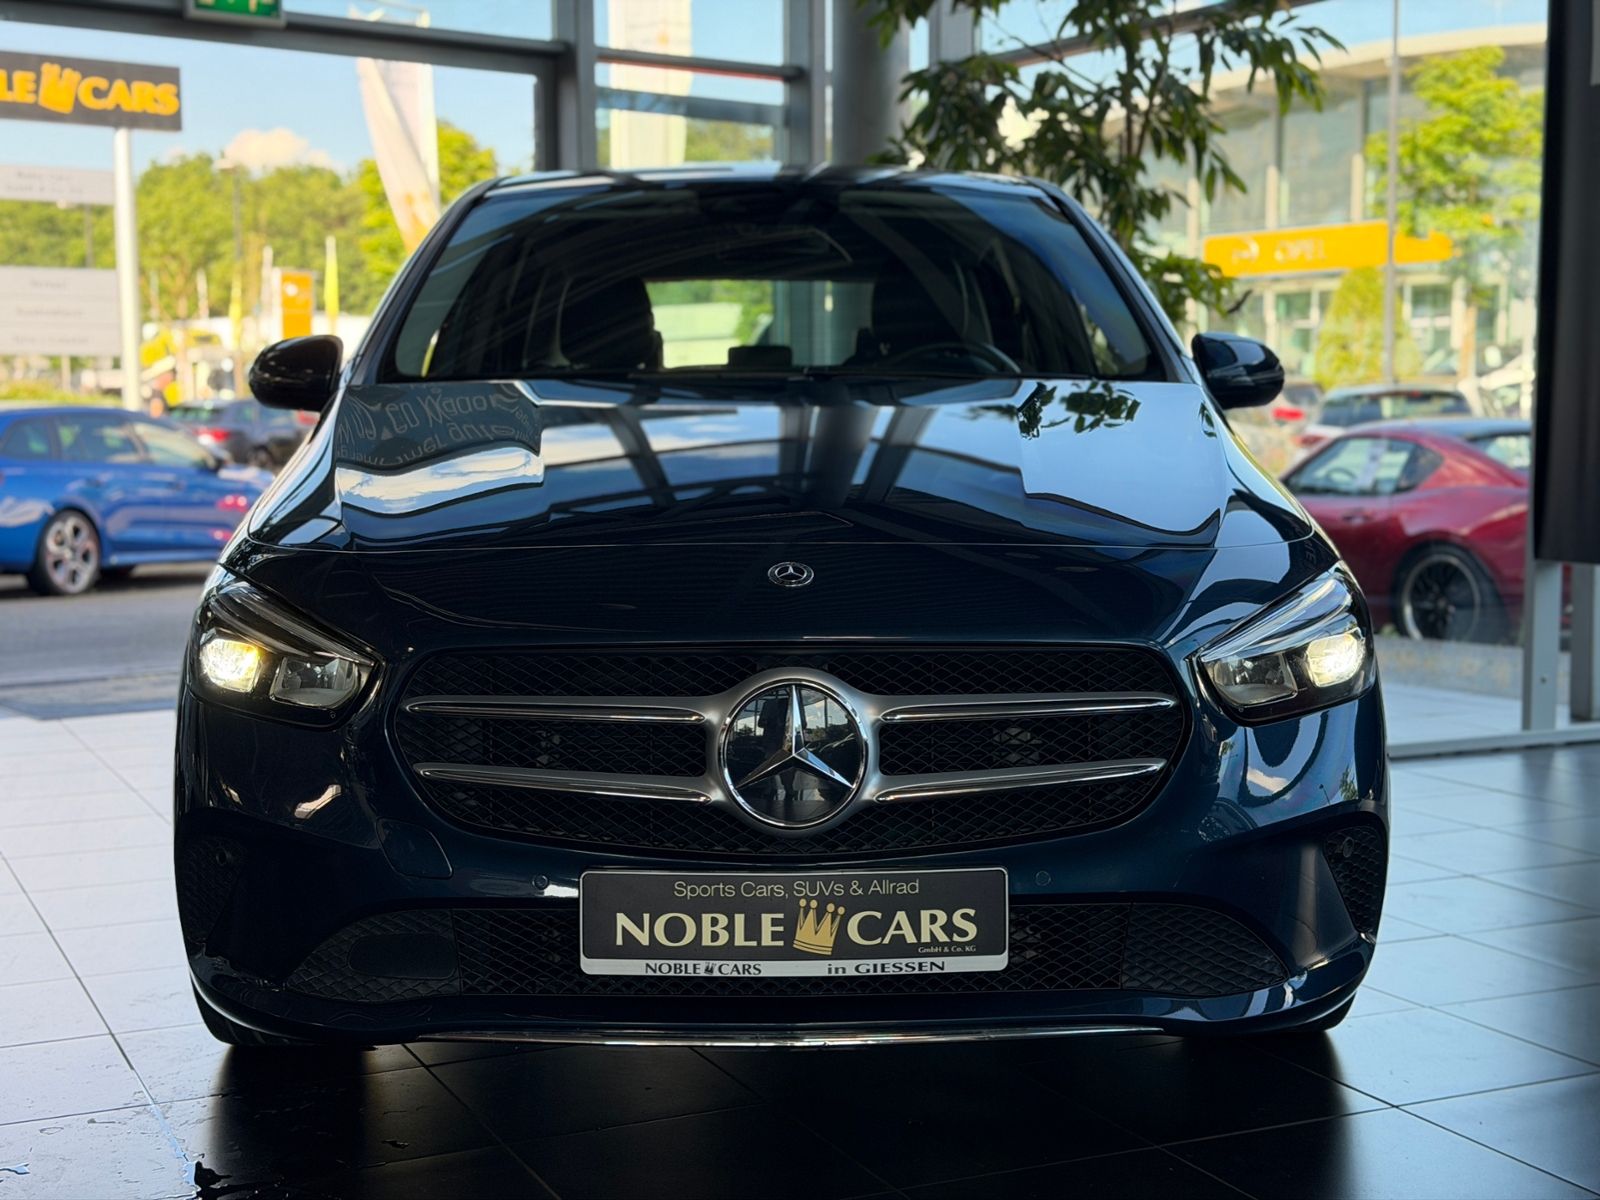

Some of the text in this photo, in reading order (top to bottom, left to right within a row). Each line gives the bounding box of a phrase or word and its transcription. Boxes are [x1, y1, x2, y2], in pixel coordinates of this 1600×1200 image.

[77, 76, 180, 116] CARS
[674, 878, 920, 900] Sports Cars, SUVs & Allrad
[615, 908, 978, 947] NOBLE CARS
[918, 944, 977, 954] GmbH & Co. KG
[645, 961, 945, 976] NOBLE CARS in GIESSEN
